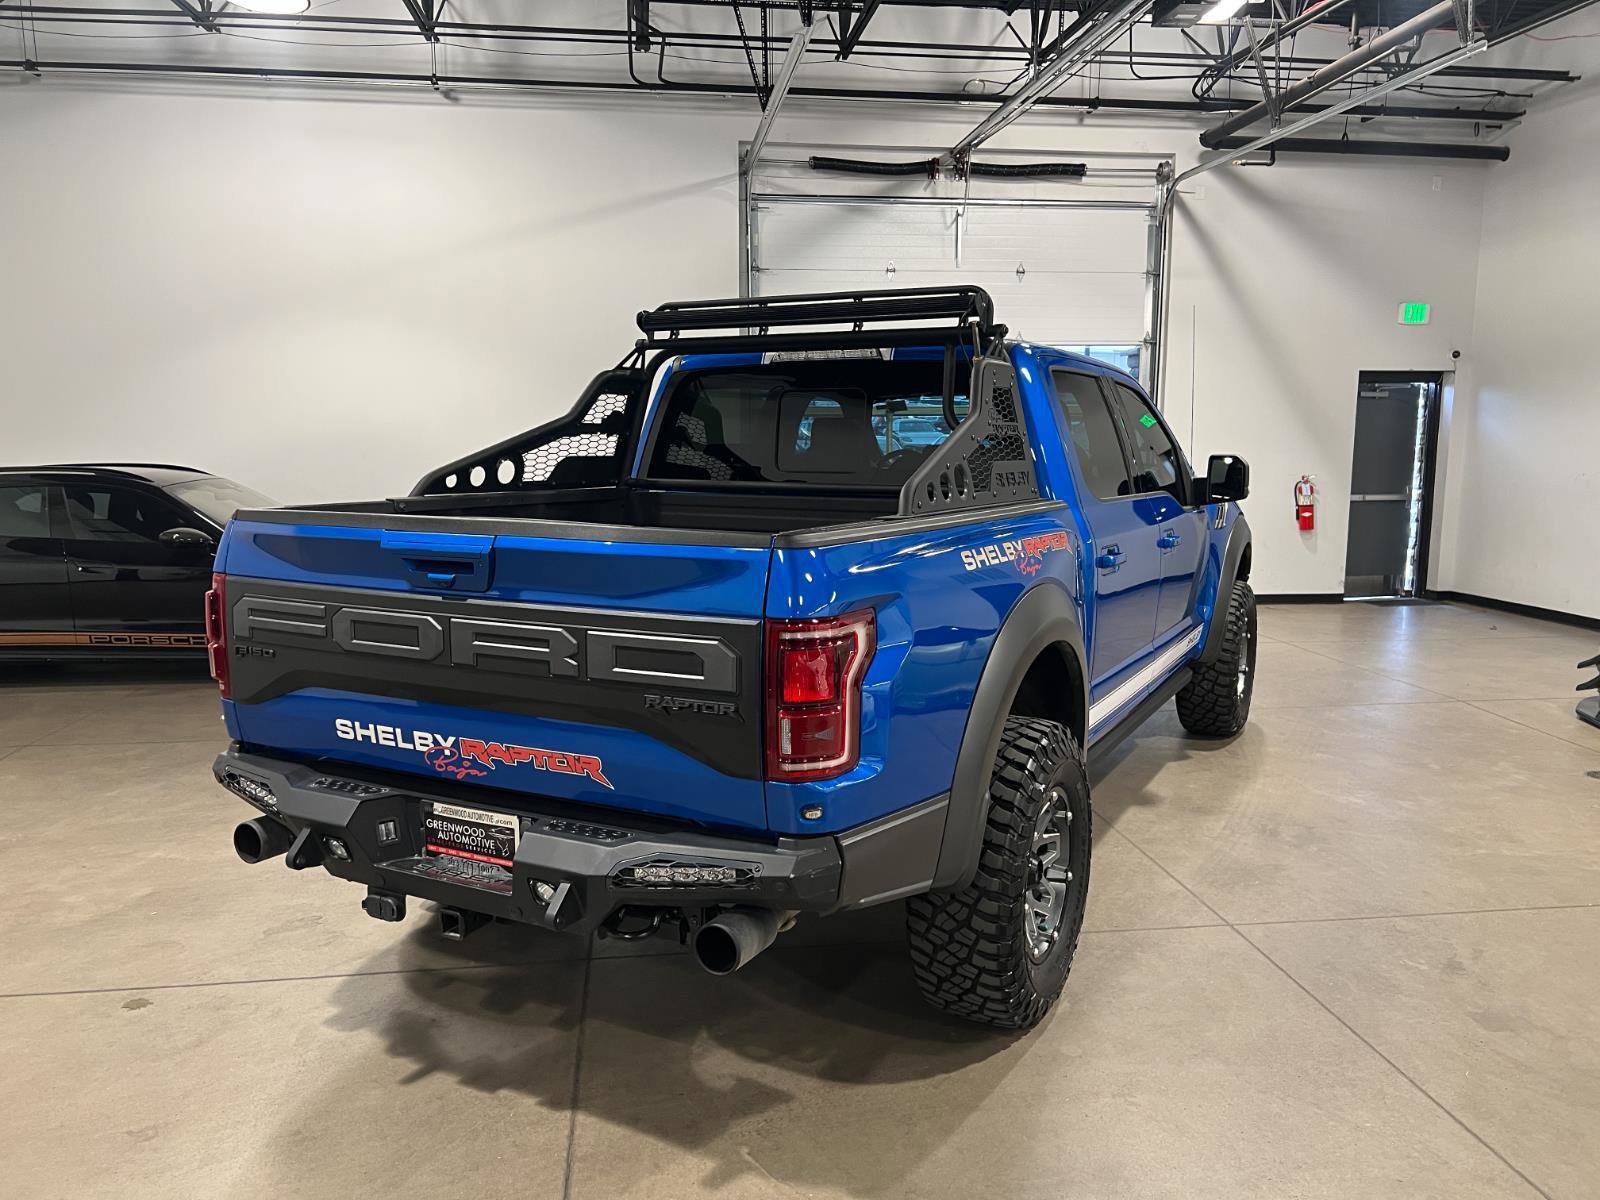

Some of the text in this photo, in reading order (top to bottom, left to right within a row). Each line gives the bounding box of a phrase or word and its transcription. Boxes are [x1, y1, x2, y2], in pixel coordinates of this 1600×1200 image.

[960, 531, 1075, 572] SHELBY RAPTOR
[90, 634, 208, 646] PORSCH
[231, 596, 740, 696] FORD
[642, 694, 745, 723] RAPTOR
[335, 718, 615, 791] SHELBY RAPTOR
[425, 746, 488, 779] Baja
[426, 819, 486, 838] GREENWOOD
[437, 831, 495, 849] AUTOMOTIVE
